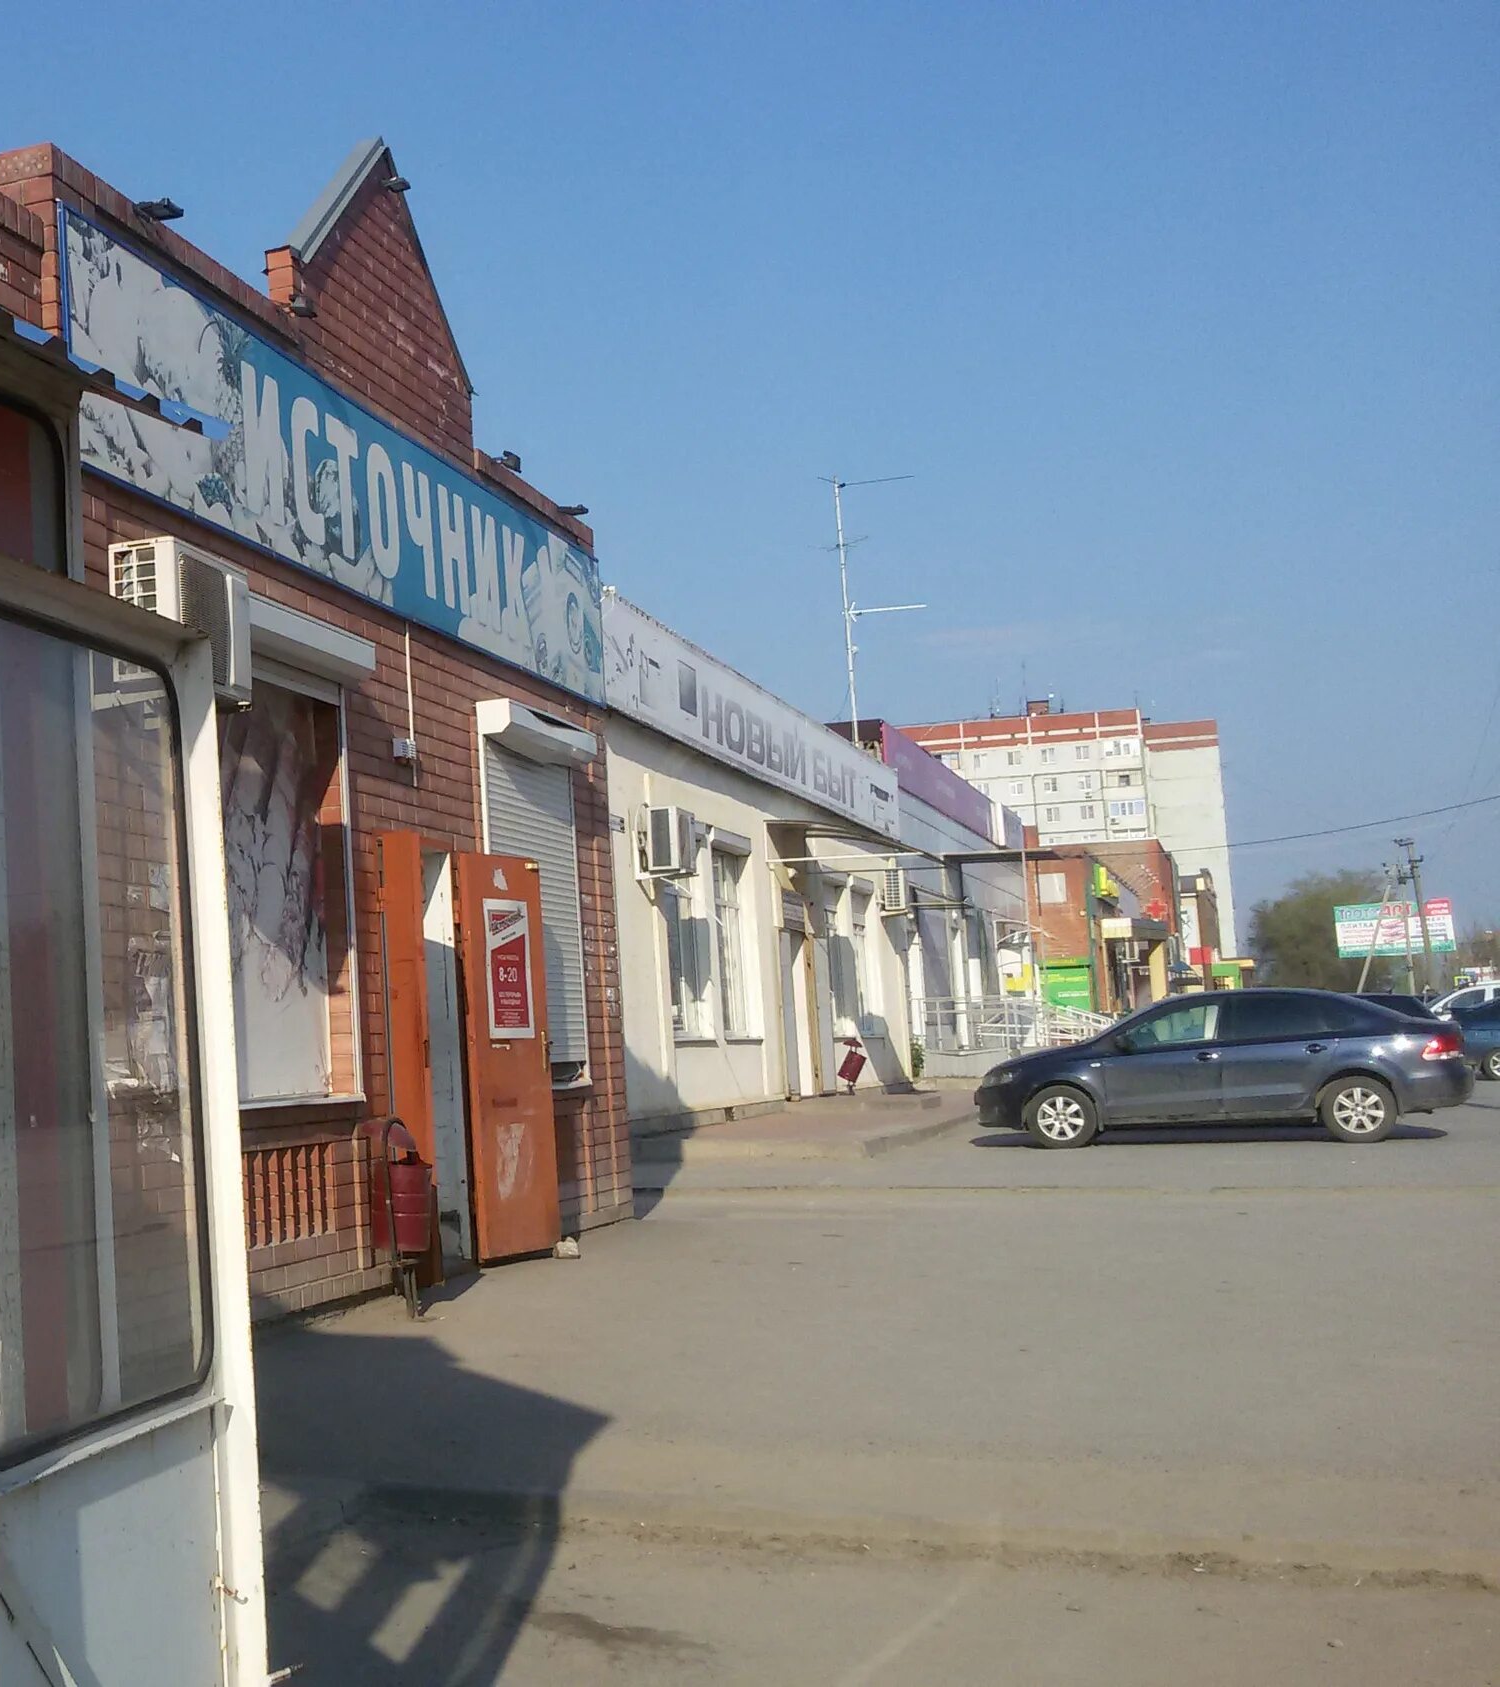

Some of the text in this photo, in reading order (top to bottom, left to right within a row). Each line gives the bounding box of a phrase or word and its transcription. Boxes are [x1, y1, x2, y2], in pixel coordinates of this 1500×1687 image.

[240, 361, 531, 647] ИСТОЧНИК
[702, 686, 856, 808] НОВЫЙ БЫТ
[499, 967, 518, 982] 8-20
